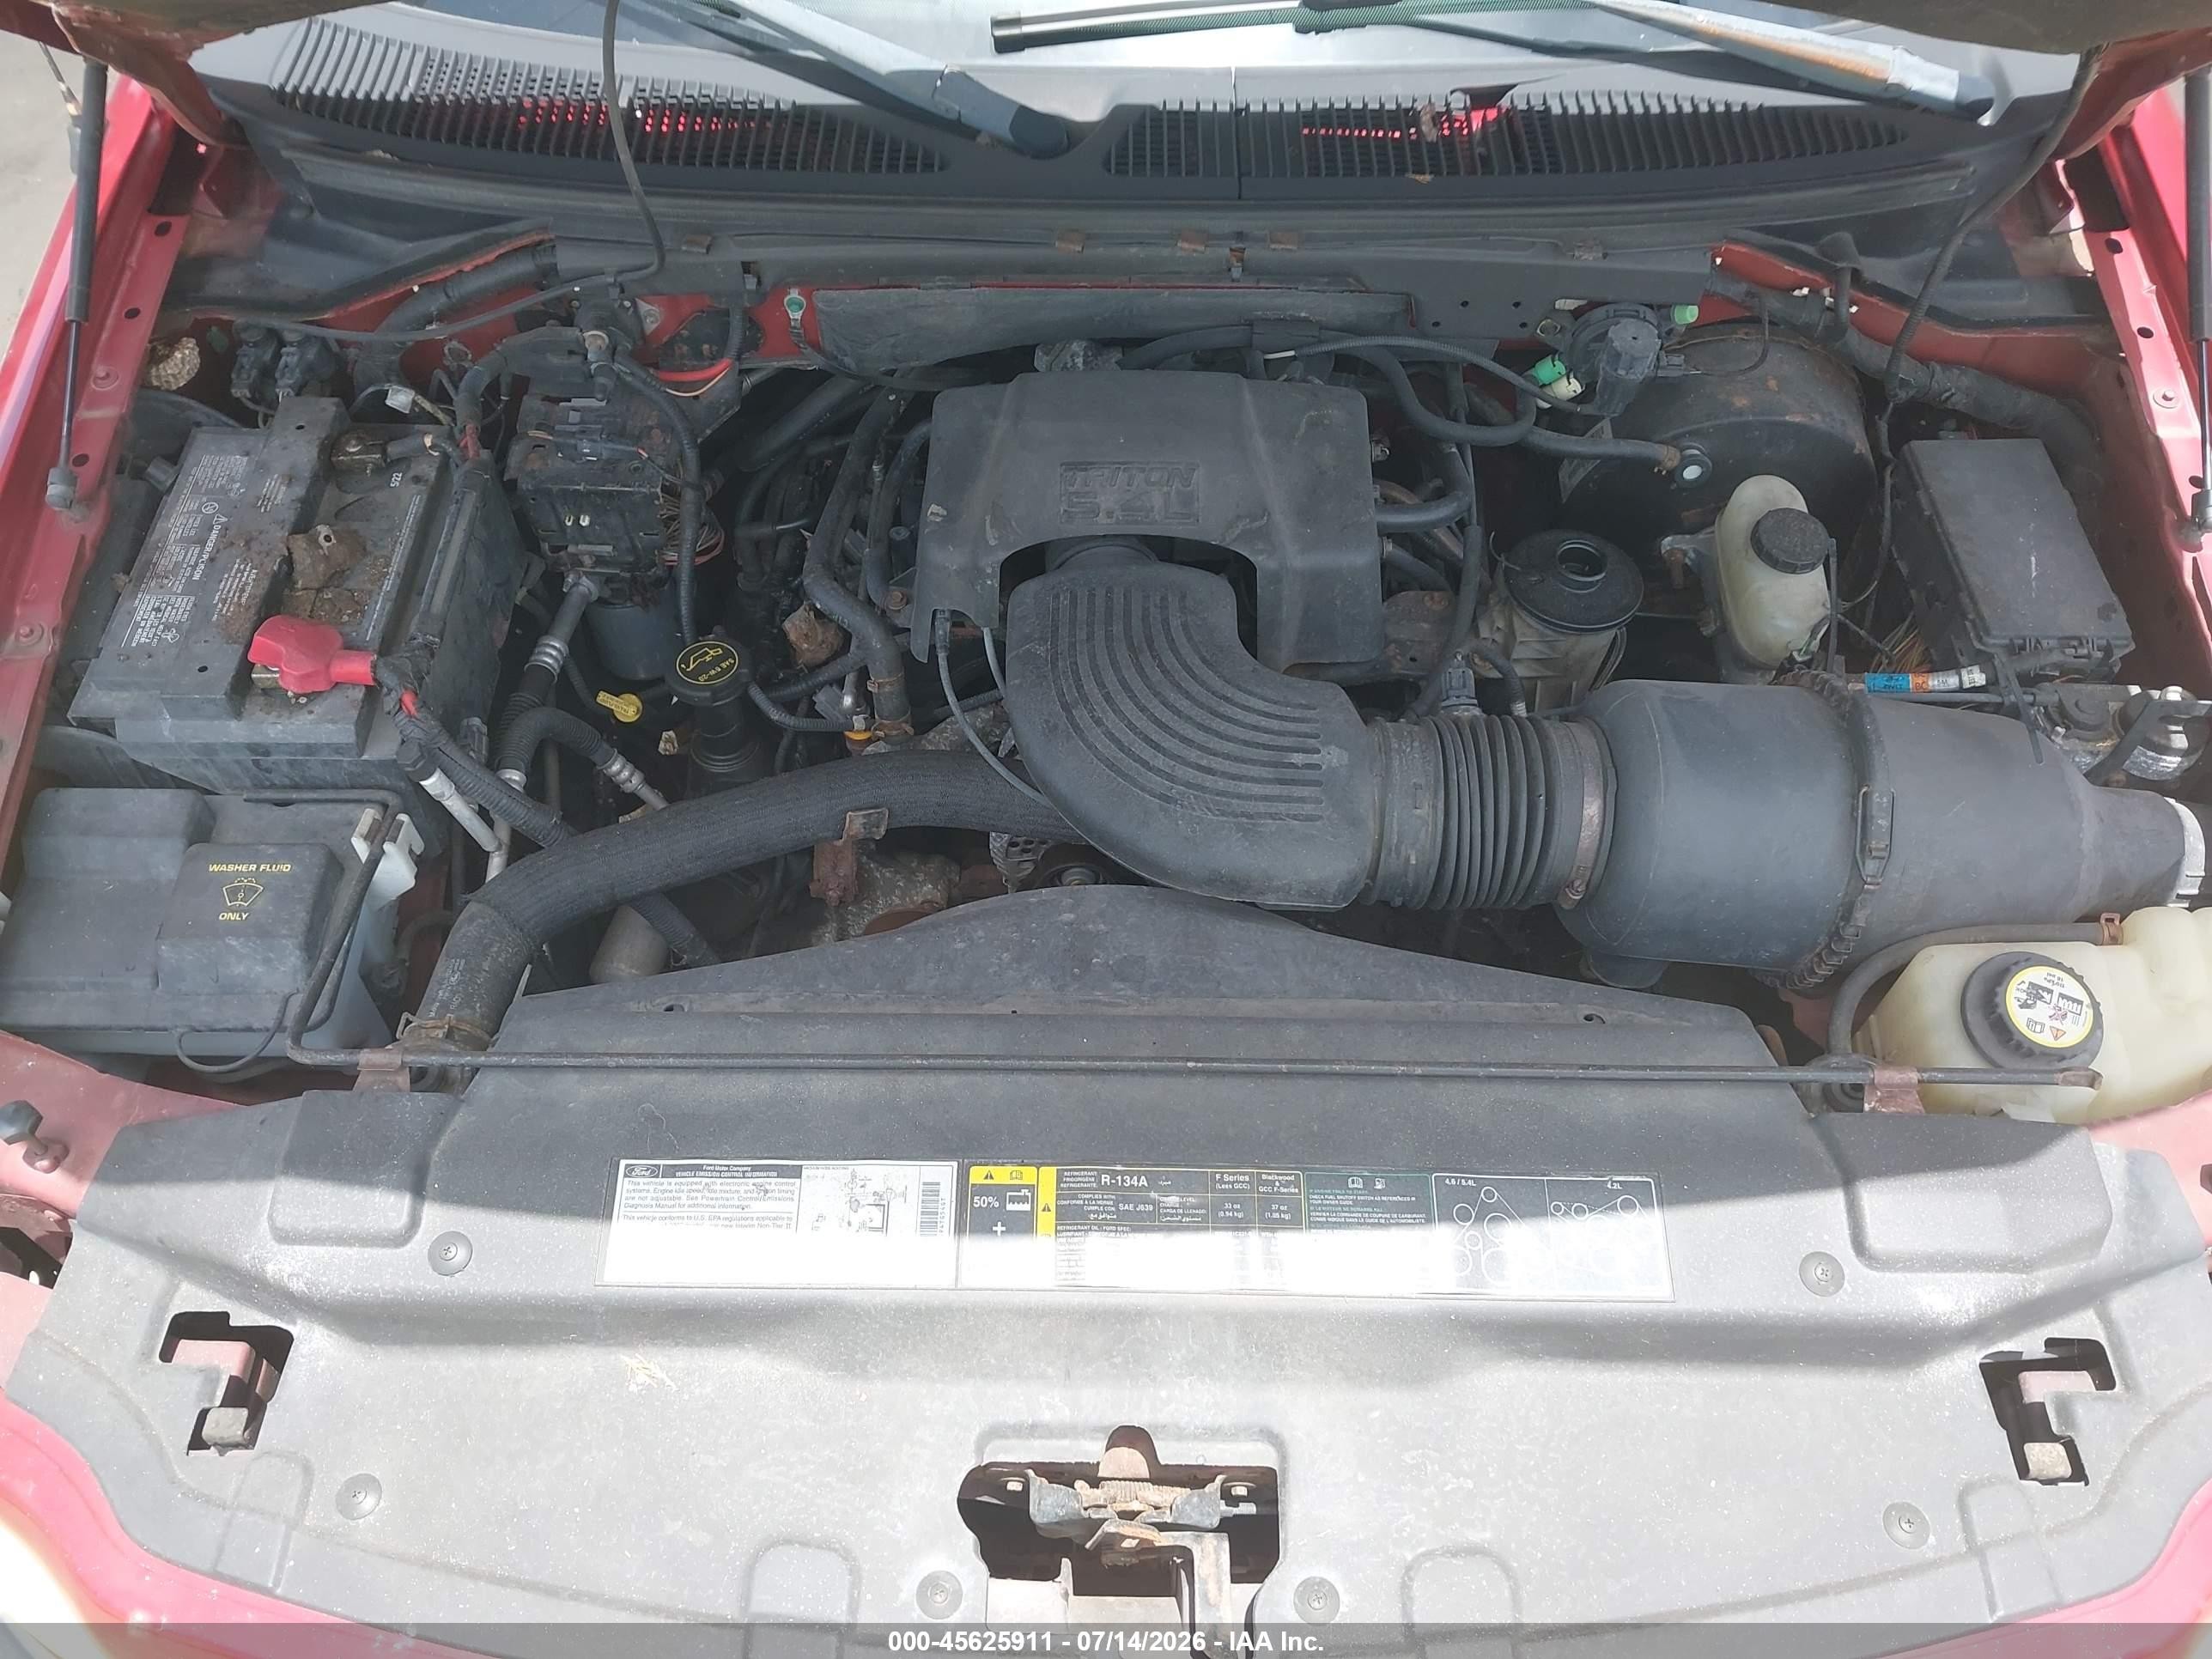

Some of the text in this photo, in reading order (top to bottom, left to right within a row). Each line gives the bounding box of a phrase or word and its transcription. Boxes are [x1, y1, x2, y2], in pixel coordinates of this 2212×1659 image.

[1065, 490, 1193, 520] 5.4L
[720, 658, 735, 668] SAE
[219, 912, 249, 921] ONLY
[631, 1167, 651, 1176] Ford
[1101, 1174, 1148, 1187] R-134A
[1607, 1181, 1622, 1189] 4.2L
[973, 1196, 999, 1208] 50%
